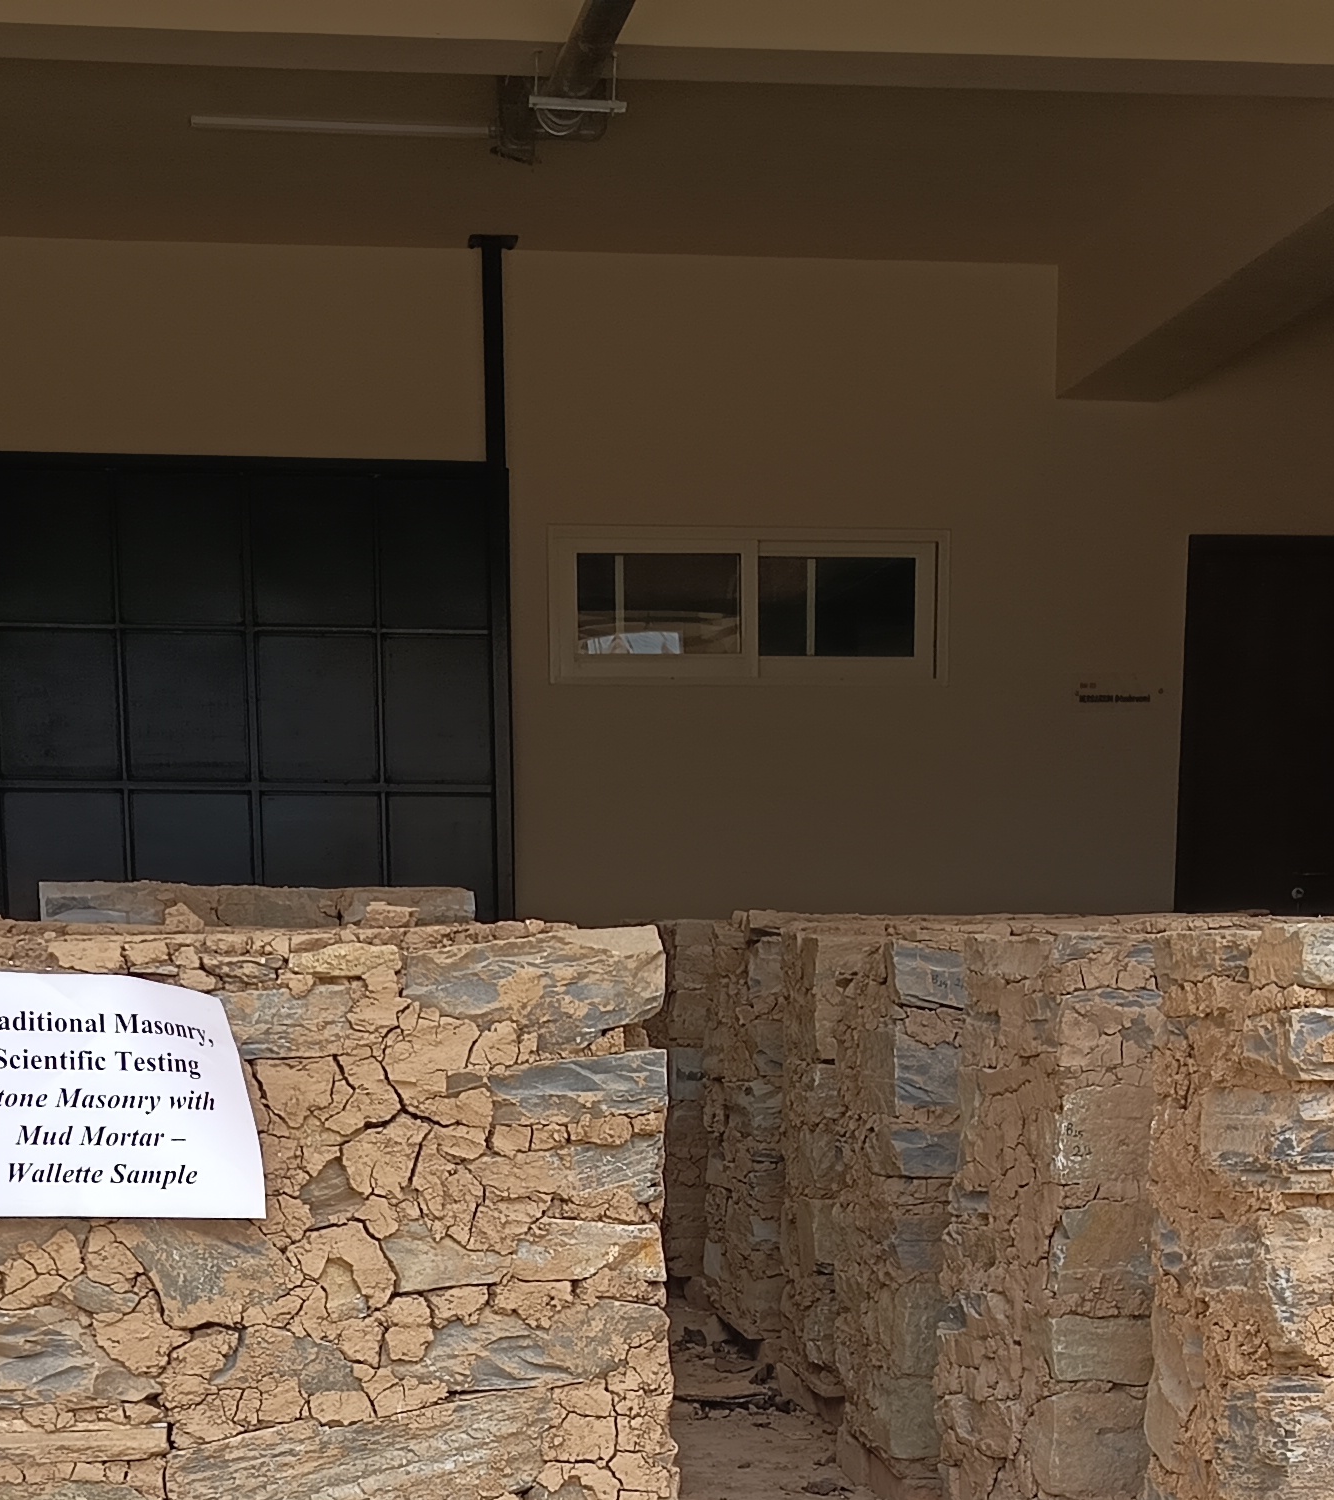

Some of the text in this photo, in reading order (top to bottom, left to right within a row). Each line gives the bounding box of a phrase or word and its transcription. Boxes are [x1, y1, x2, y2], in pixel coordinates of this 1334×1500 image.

[114, 1013, 214, 1048] Masonry,
[114, 1050, 202, 1080] Testing
[54, 1087, 161, 1115] Masonry
[169, 1091, 215, 1112] with
[15, 1125, 73, 1147] Mud
[78, 1126, 165, 1148] Mortar
[7, 1162, 198, 1190] Wallette Sample
